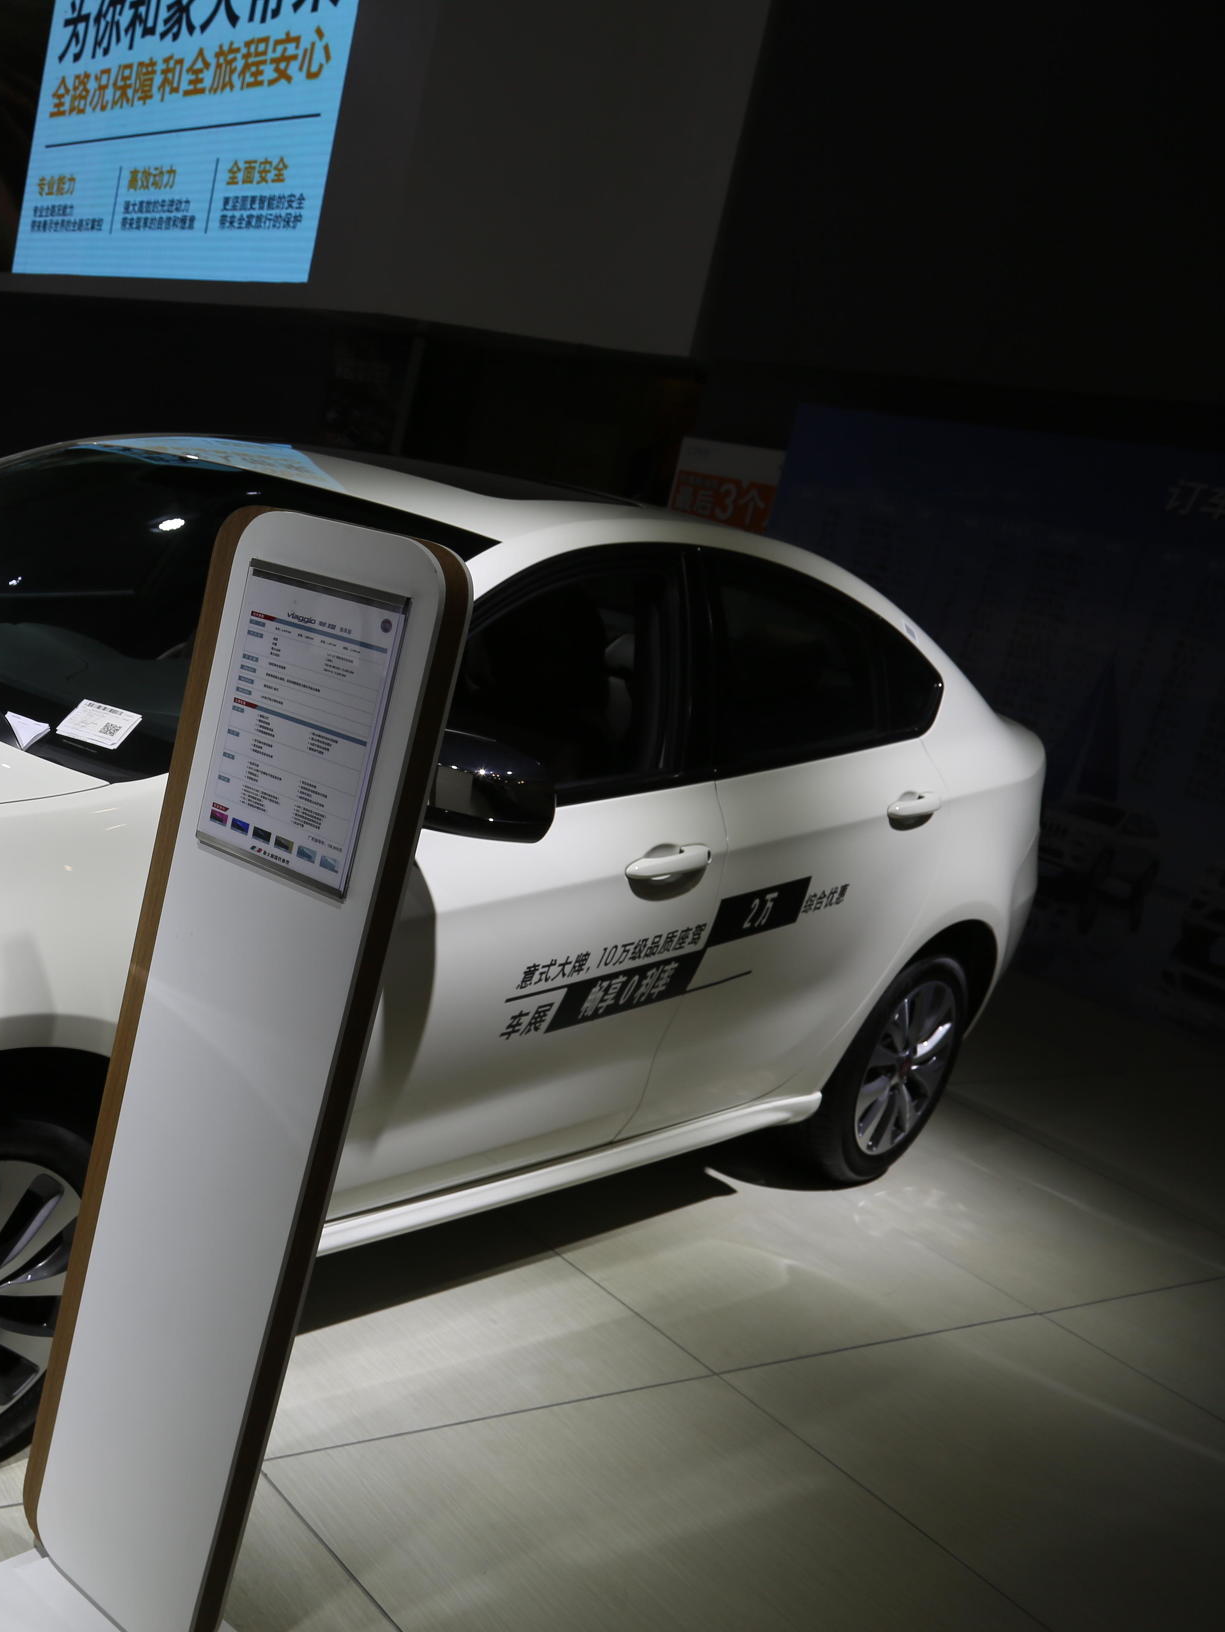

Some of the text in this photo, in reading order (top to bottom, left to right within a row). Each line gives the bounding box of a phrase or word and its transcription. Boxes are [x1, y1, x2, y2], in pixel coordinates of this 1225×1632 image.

[49, 26, 332, 119] 全路况保障和全旅程安心
[37, 175, 76, 197] 专业能力
[127, 165, 177, 191] 高效动力
[226, 156, 289, 187] 全面安全
[287, 610, 317, 625] viaggio
[742, 882, 851, 930] 2万 综合优惠
[499, 1001, 555, 1041] 车展
